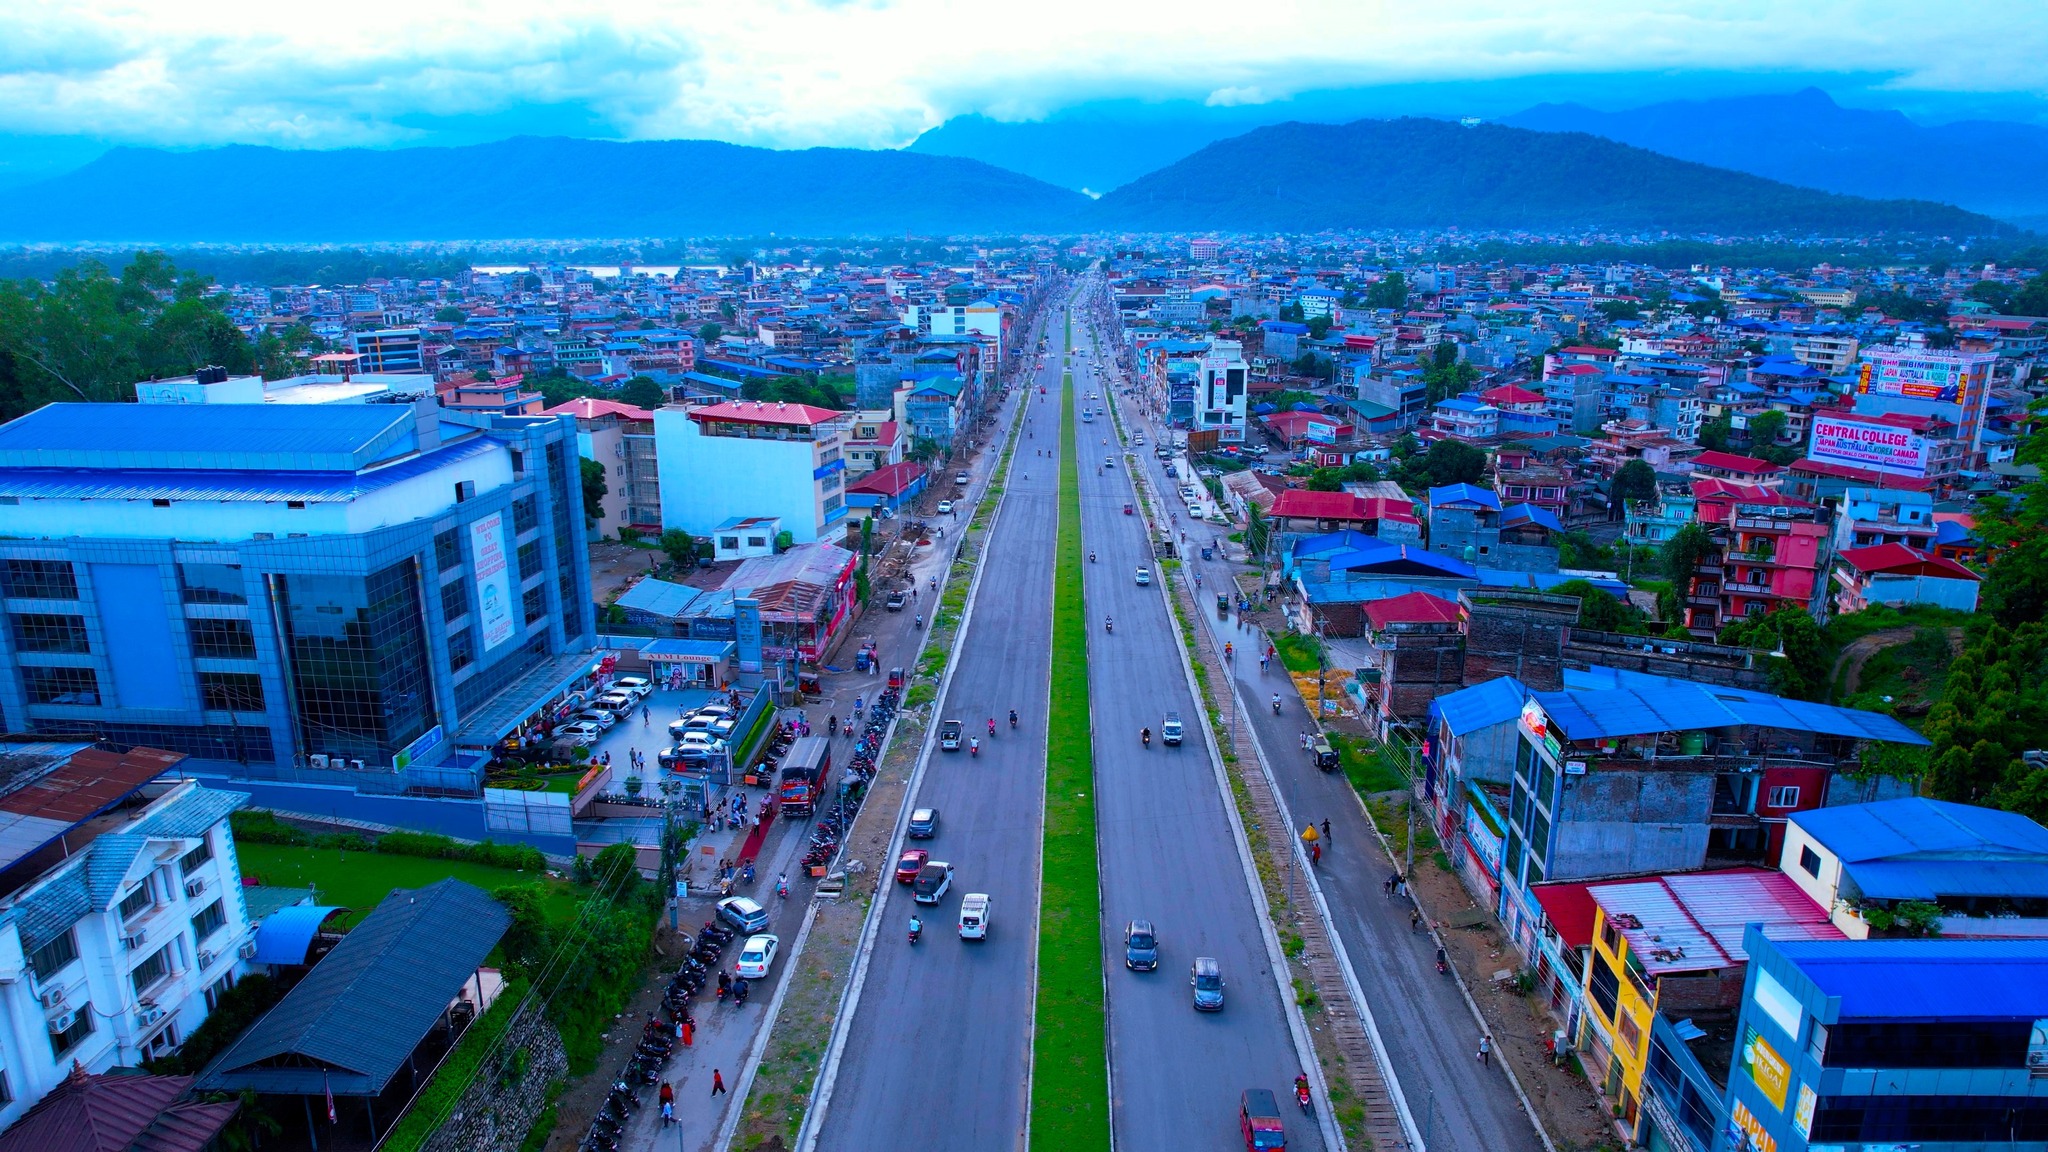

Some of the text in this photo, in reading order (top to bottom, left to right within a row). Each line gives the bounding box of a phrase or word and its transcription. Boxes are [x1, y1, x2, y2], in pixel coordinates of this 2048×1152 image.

[1908, 360, 1924, 368] BIM
[1934, 363, 1949, 371] BBS
[1883, 368, 1897, 377] JAPAN
[1899, 369, 1924, 380] AUSTRALIA
[1931, 371, 1948, 381] KOREA
[1815, 423, 1860, 441] CENTRAL
[1861, 430, 1908, 447] COLLEGE
[1816, 446, 1842, 455] BHARATPUR
[1817, 438, 1836, 448] JAPAN
[1835, 439, 1868, 452] AUSTRALIA
[1892, 448, 1919, 460] CANADA
[475, 516, 500, 535] WELCOME
[484, 532, 492, 542] TO
[476, 550, 503, 571] SHOPPING
[677, 654, 712, 662] Lounge
[1756, 1055, 1783, 1090] IKIGAI
[1733, 1101, 1777, 1152] JAPAN
